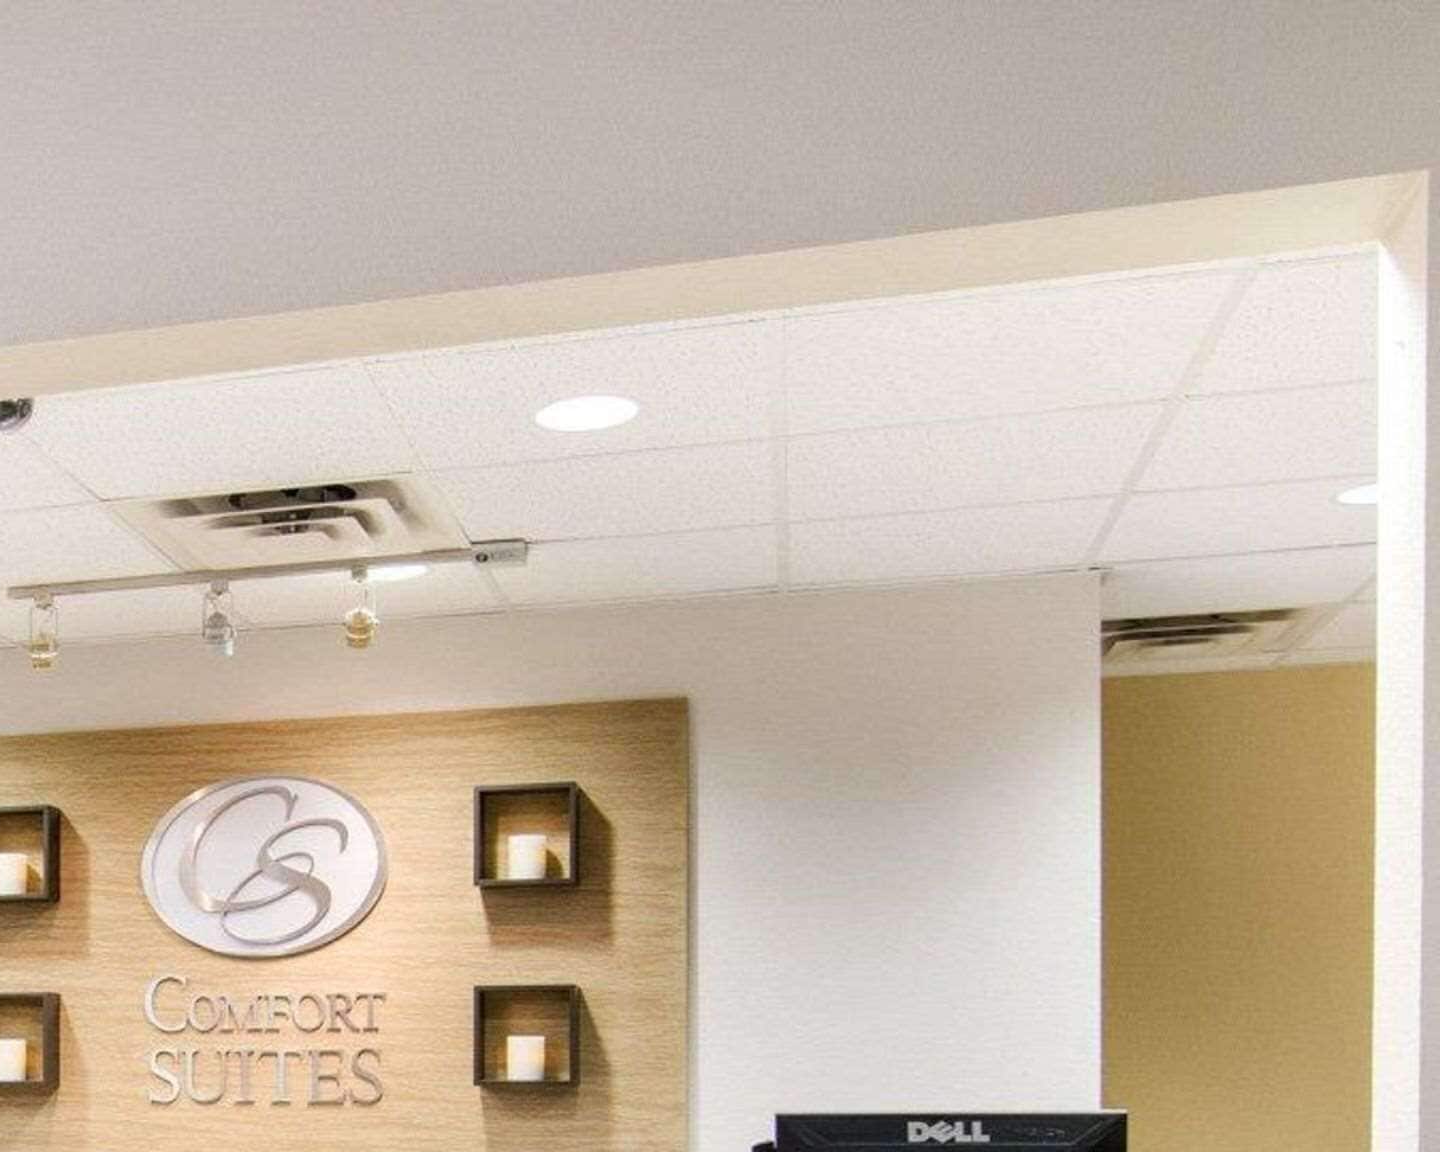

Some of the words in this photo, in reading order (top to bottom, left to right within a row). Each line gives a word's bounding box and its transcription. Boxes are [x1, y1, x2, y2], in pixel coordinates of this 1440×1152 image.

[144, 975, 387, 1035] COMFORT
[147, 1048, 386, 1106] SUITES
[907, 1120, 991, 1144] DELL
